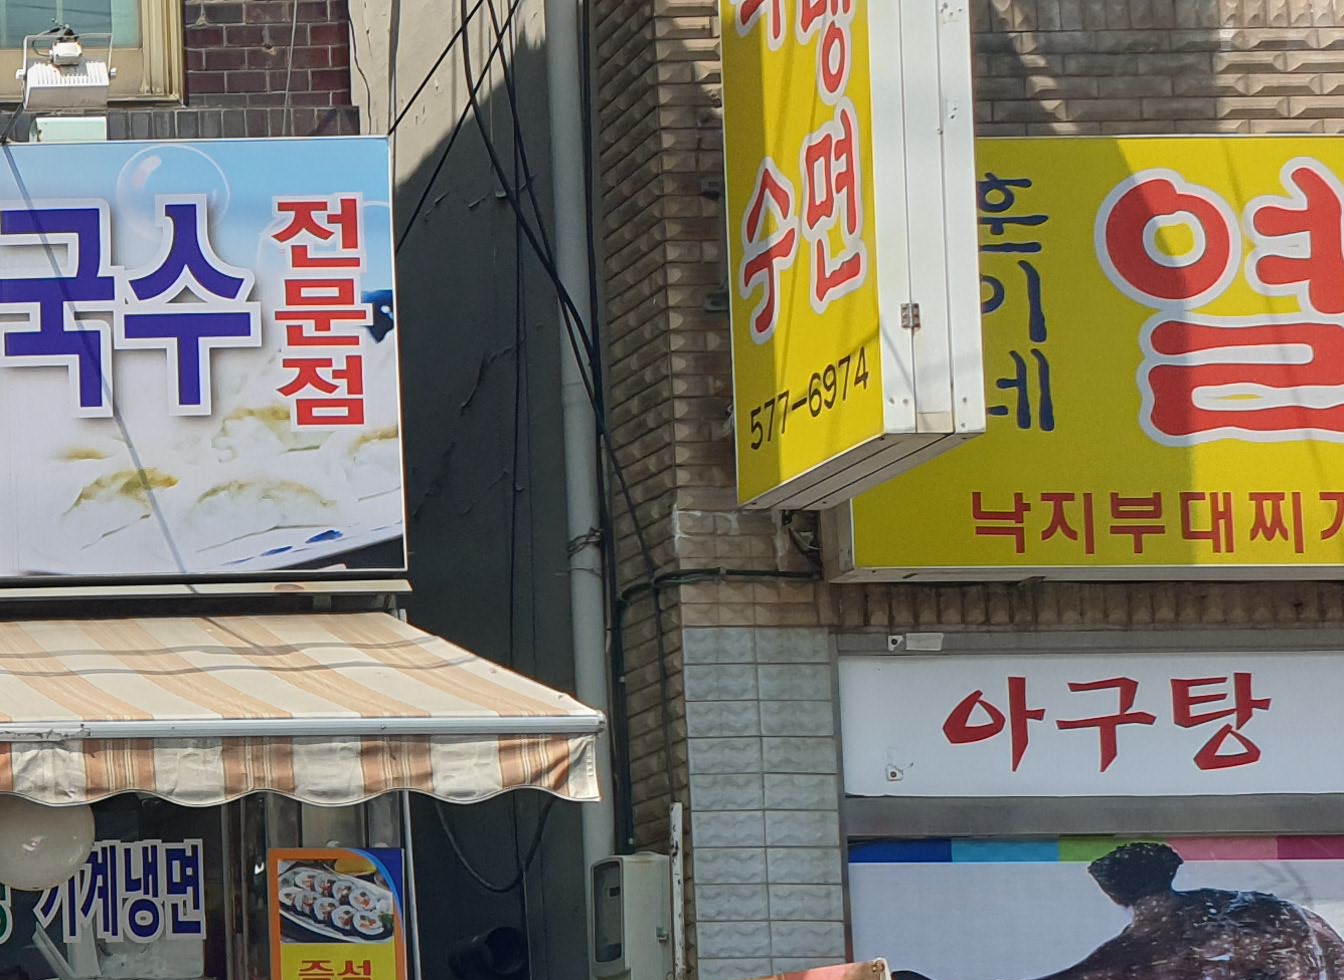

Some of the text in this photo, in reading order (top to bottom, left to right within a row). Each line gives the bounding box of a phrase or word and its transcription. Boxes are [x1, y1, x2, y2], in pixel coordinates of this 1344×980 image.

[274, 197, 368, 426] 전문점
[750, 346, 869, 452] 577-6974
[942, 672, 1272, 772] 아구탕
